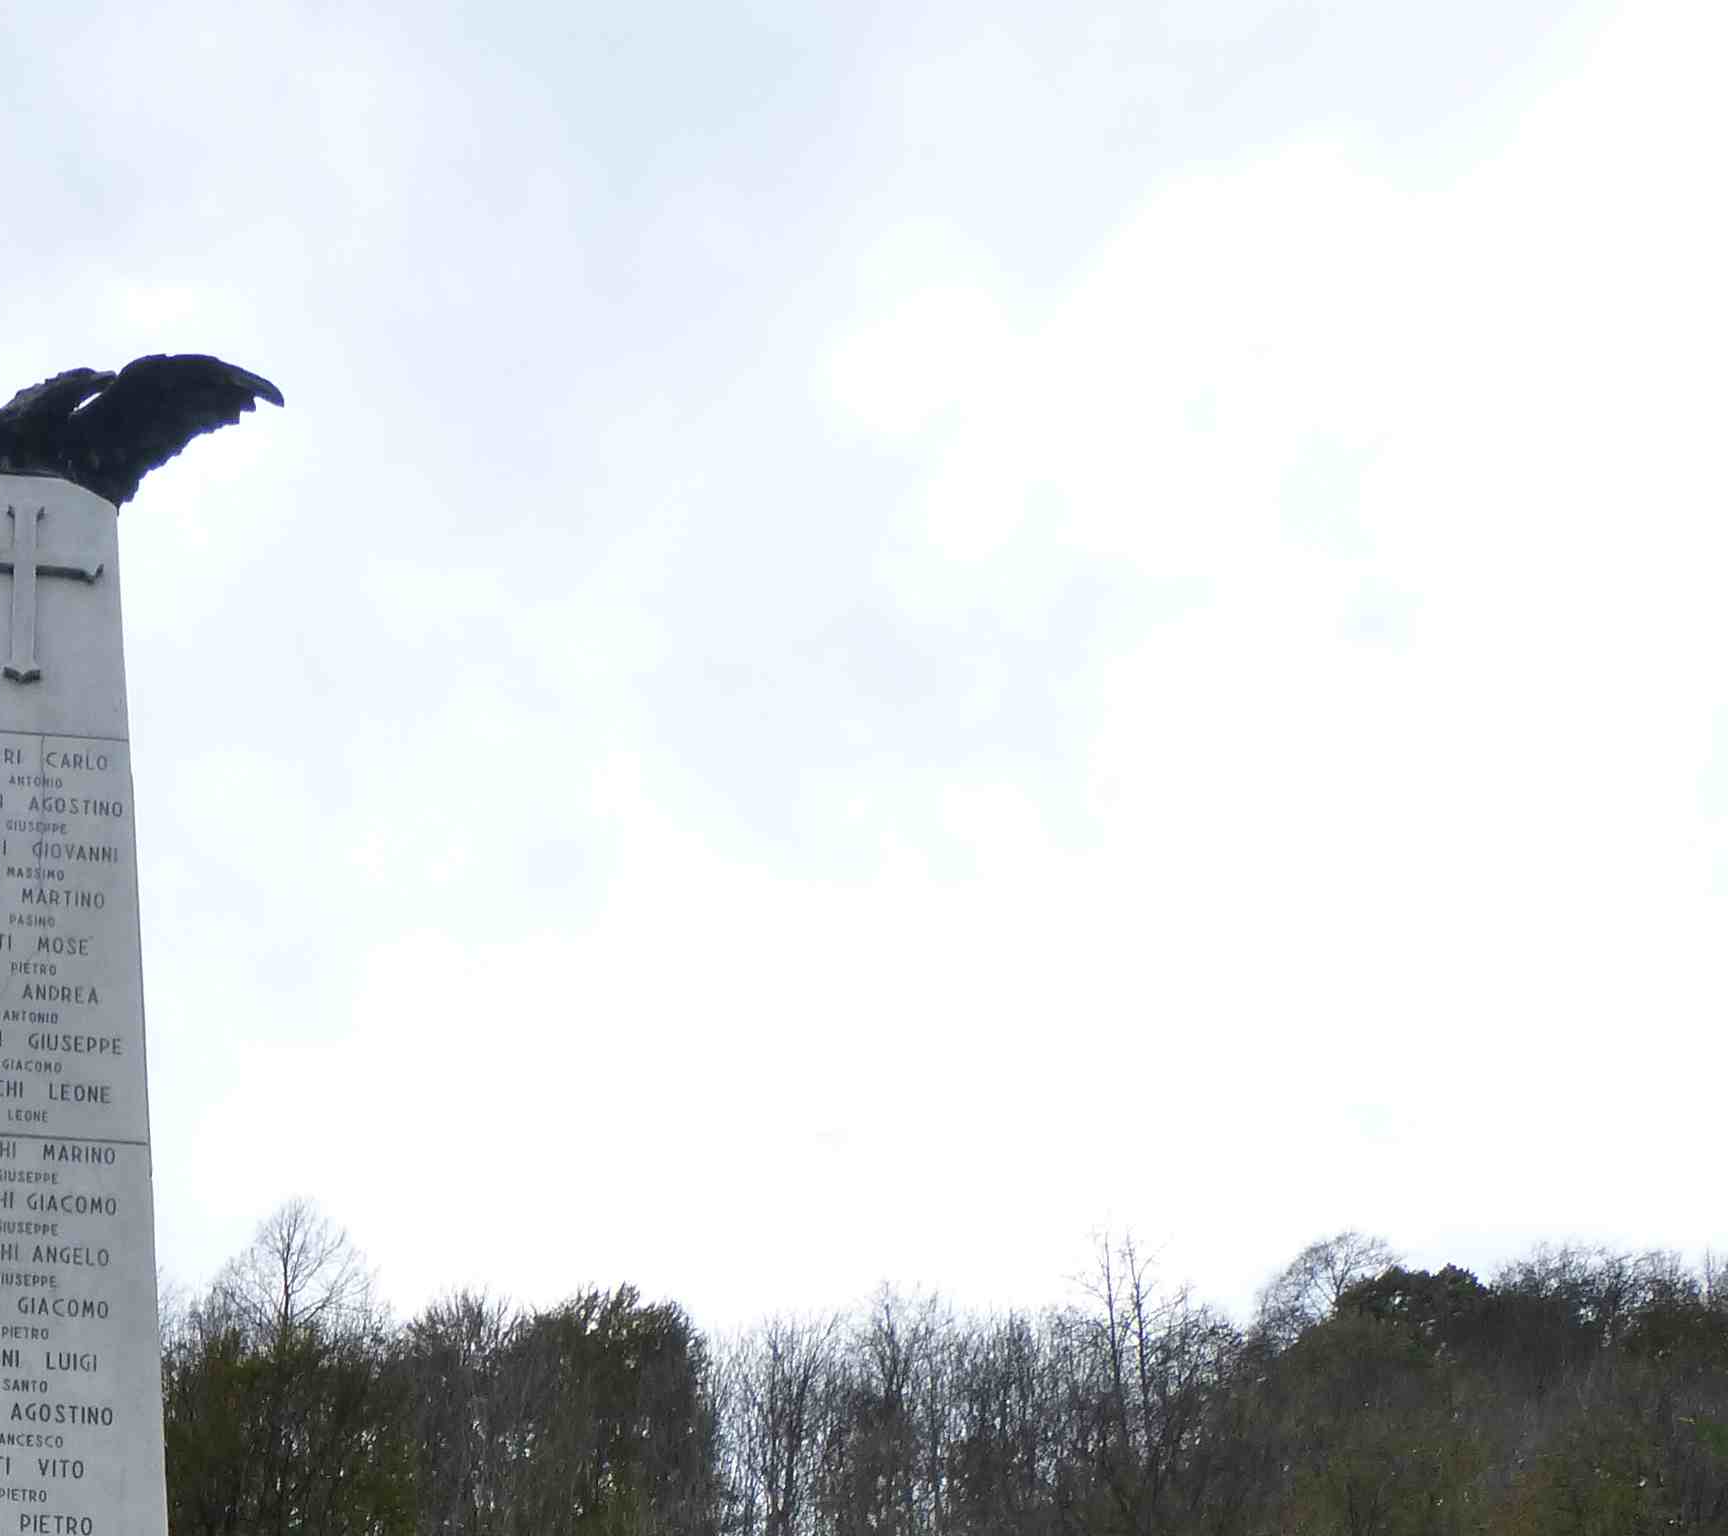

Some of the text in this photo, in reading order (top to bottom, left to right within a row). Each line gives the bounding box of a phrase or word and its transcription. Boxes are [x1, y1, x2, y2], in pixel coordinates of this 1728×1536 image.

[46, 752, 108, 770] CARLO
[9, 775, 63, 789] ANTONIO
[28, 797, 123, 818] AGOSTINO
[6, 819, 67, 835] GIUSEPPE
[32, 840, 118, 863] GIOVANNI
[6, 866, 65, 881] MASSIMO
[22, 888, 105, 909] MARTINO
[11, 962, 57, 976] PIETRO
[22, 984, 99, 1004] ANDREA
[3, 1010, 58, 1024] ANTONIO
[28, 1032, 123, 1056] GIUSEPPE
[2, 1059, 62, 1073] GIACOMO
[49, 1083, 111, 1104] LEONE
[8, 1109, 48, 1123] LEONE
[43, 1143, 116, 1165] MARINO
[26, 1192, 117, 1216] GIACOMO
[32, 1245, 110, 1267] ANGELO
[17, 1296, 109, 1320] GIACOMO
[1, 1326, 49, 1340] PIETRO
[46, 1351, 98, 1373] LUIGI
[2, 1378, 48, 1393] SANTO
[10, 1402, 113, 1426] AGOSTINO
[37, 1458, 85, 1479] VITO
[20, 1514, 93, 1536] PIETRO
